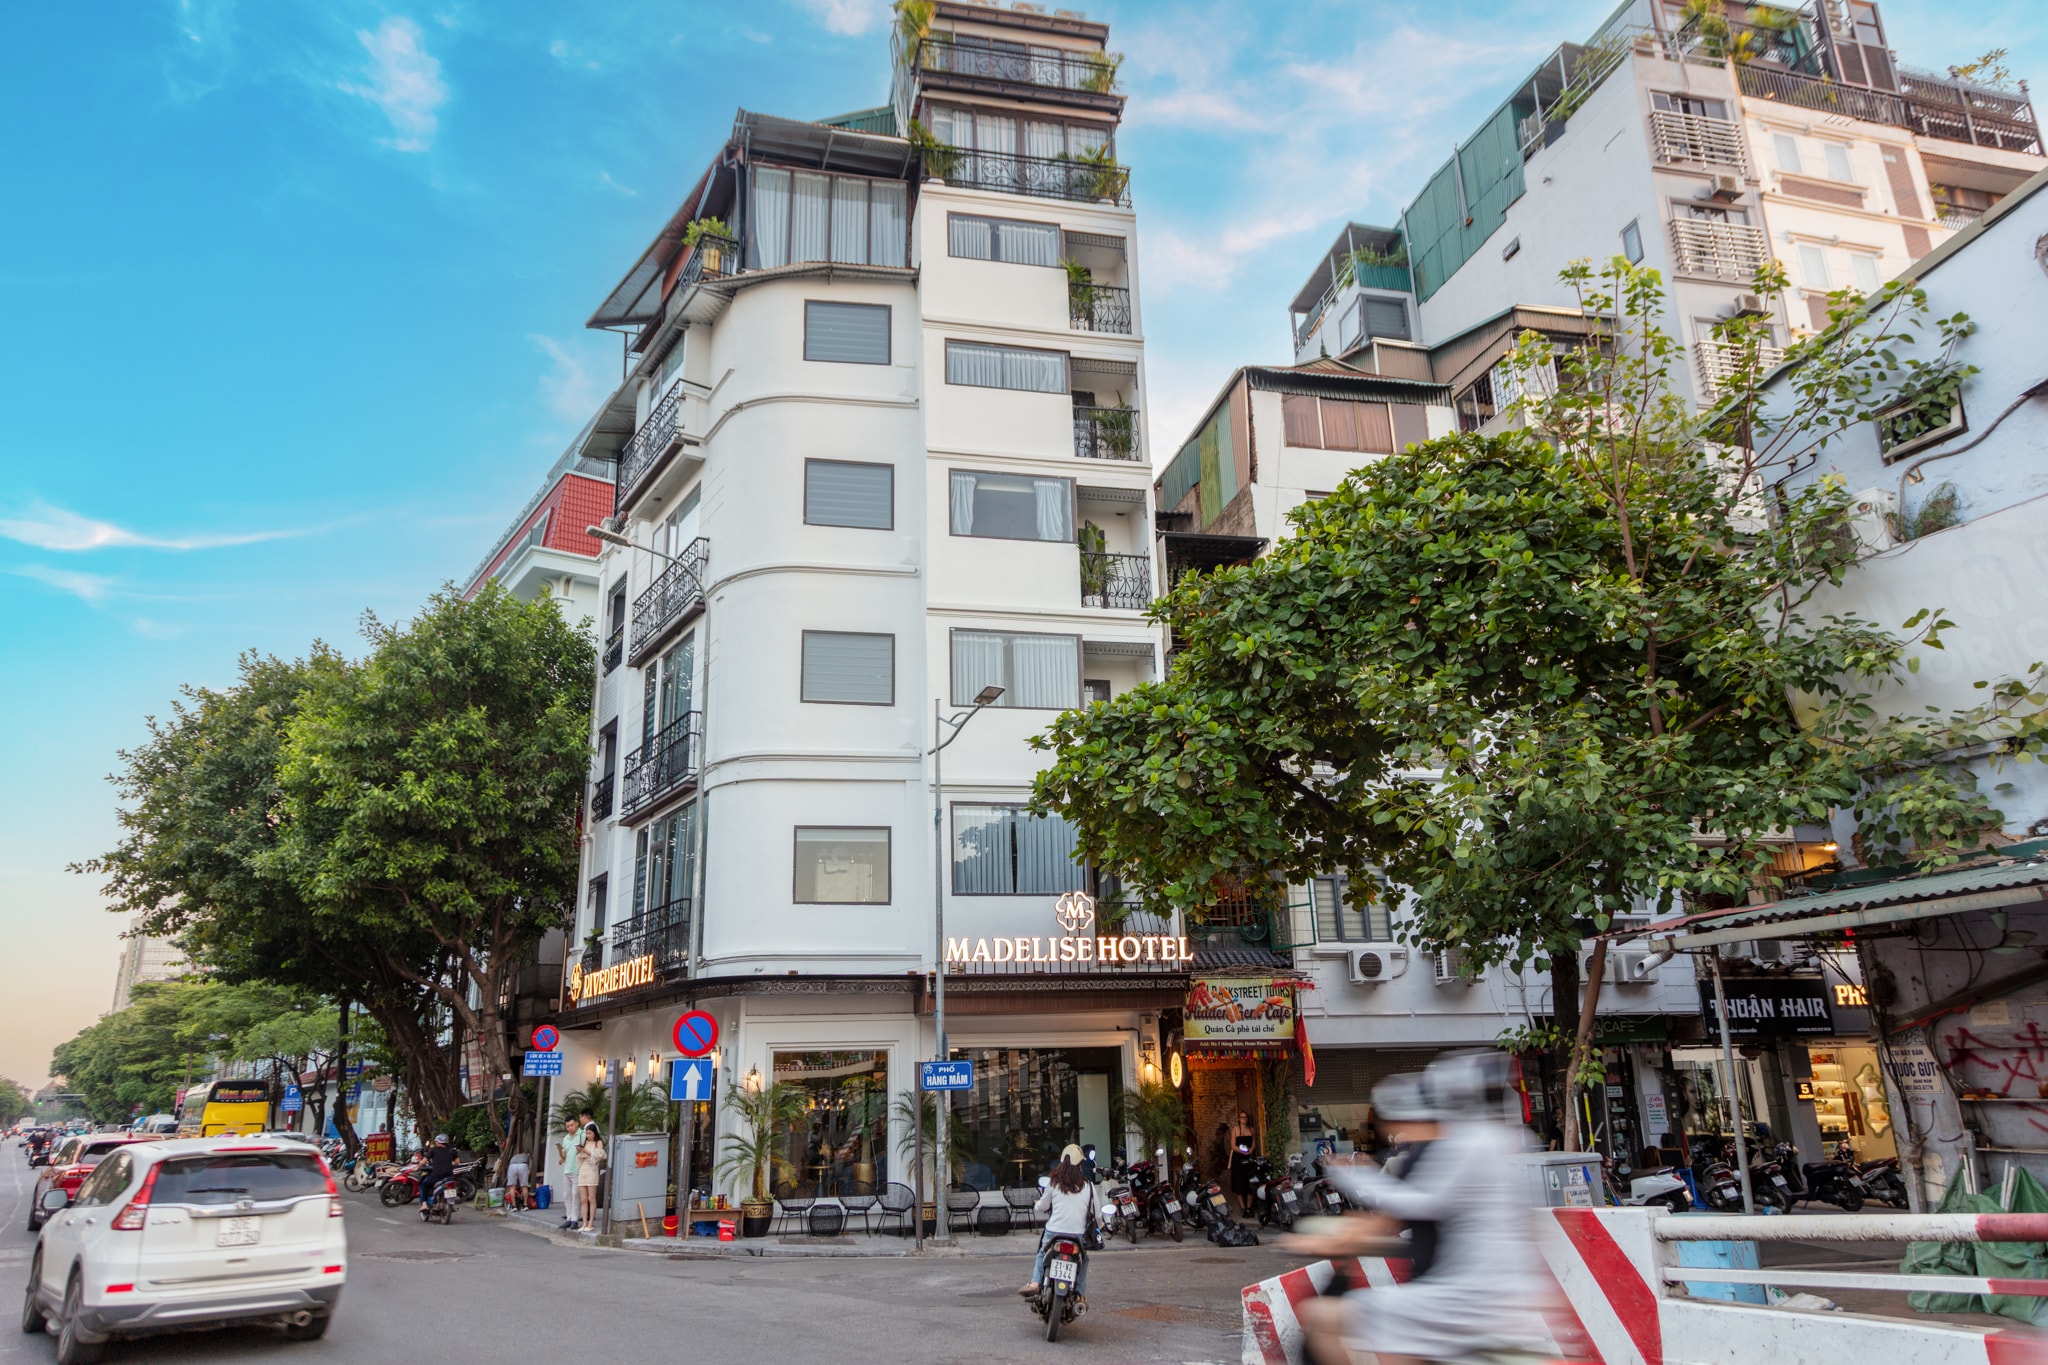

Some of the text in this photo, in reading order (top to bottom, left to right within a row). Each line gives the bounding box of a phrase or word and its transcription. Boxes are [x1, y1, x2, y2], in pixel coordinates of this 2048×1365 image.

[944, 936, 1194, 962] MADELISE HOTEL
[619, 954, 655, 990] HOTEL
[1780, 997, 1829, 1019] HAIR
[1204, 1024, 1224, 1034] Quán
[1603, 1021, 1636, 1033] CAFE
[938, 1064, 955, 1073] PHỐ
[926, 1073, 947, 1087] HÀNG
[289, 1087, 298, 1096] P
[1800, 1083, 1810, 1094] 5
[367, 1142, 376, 1153] XE
